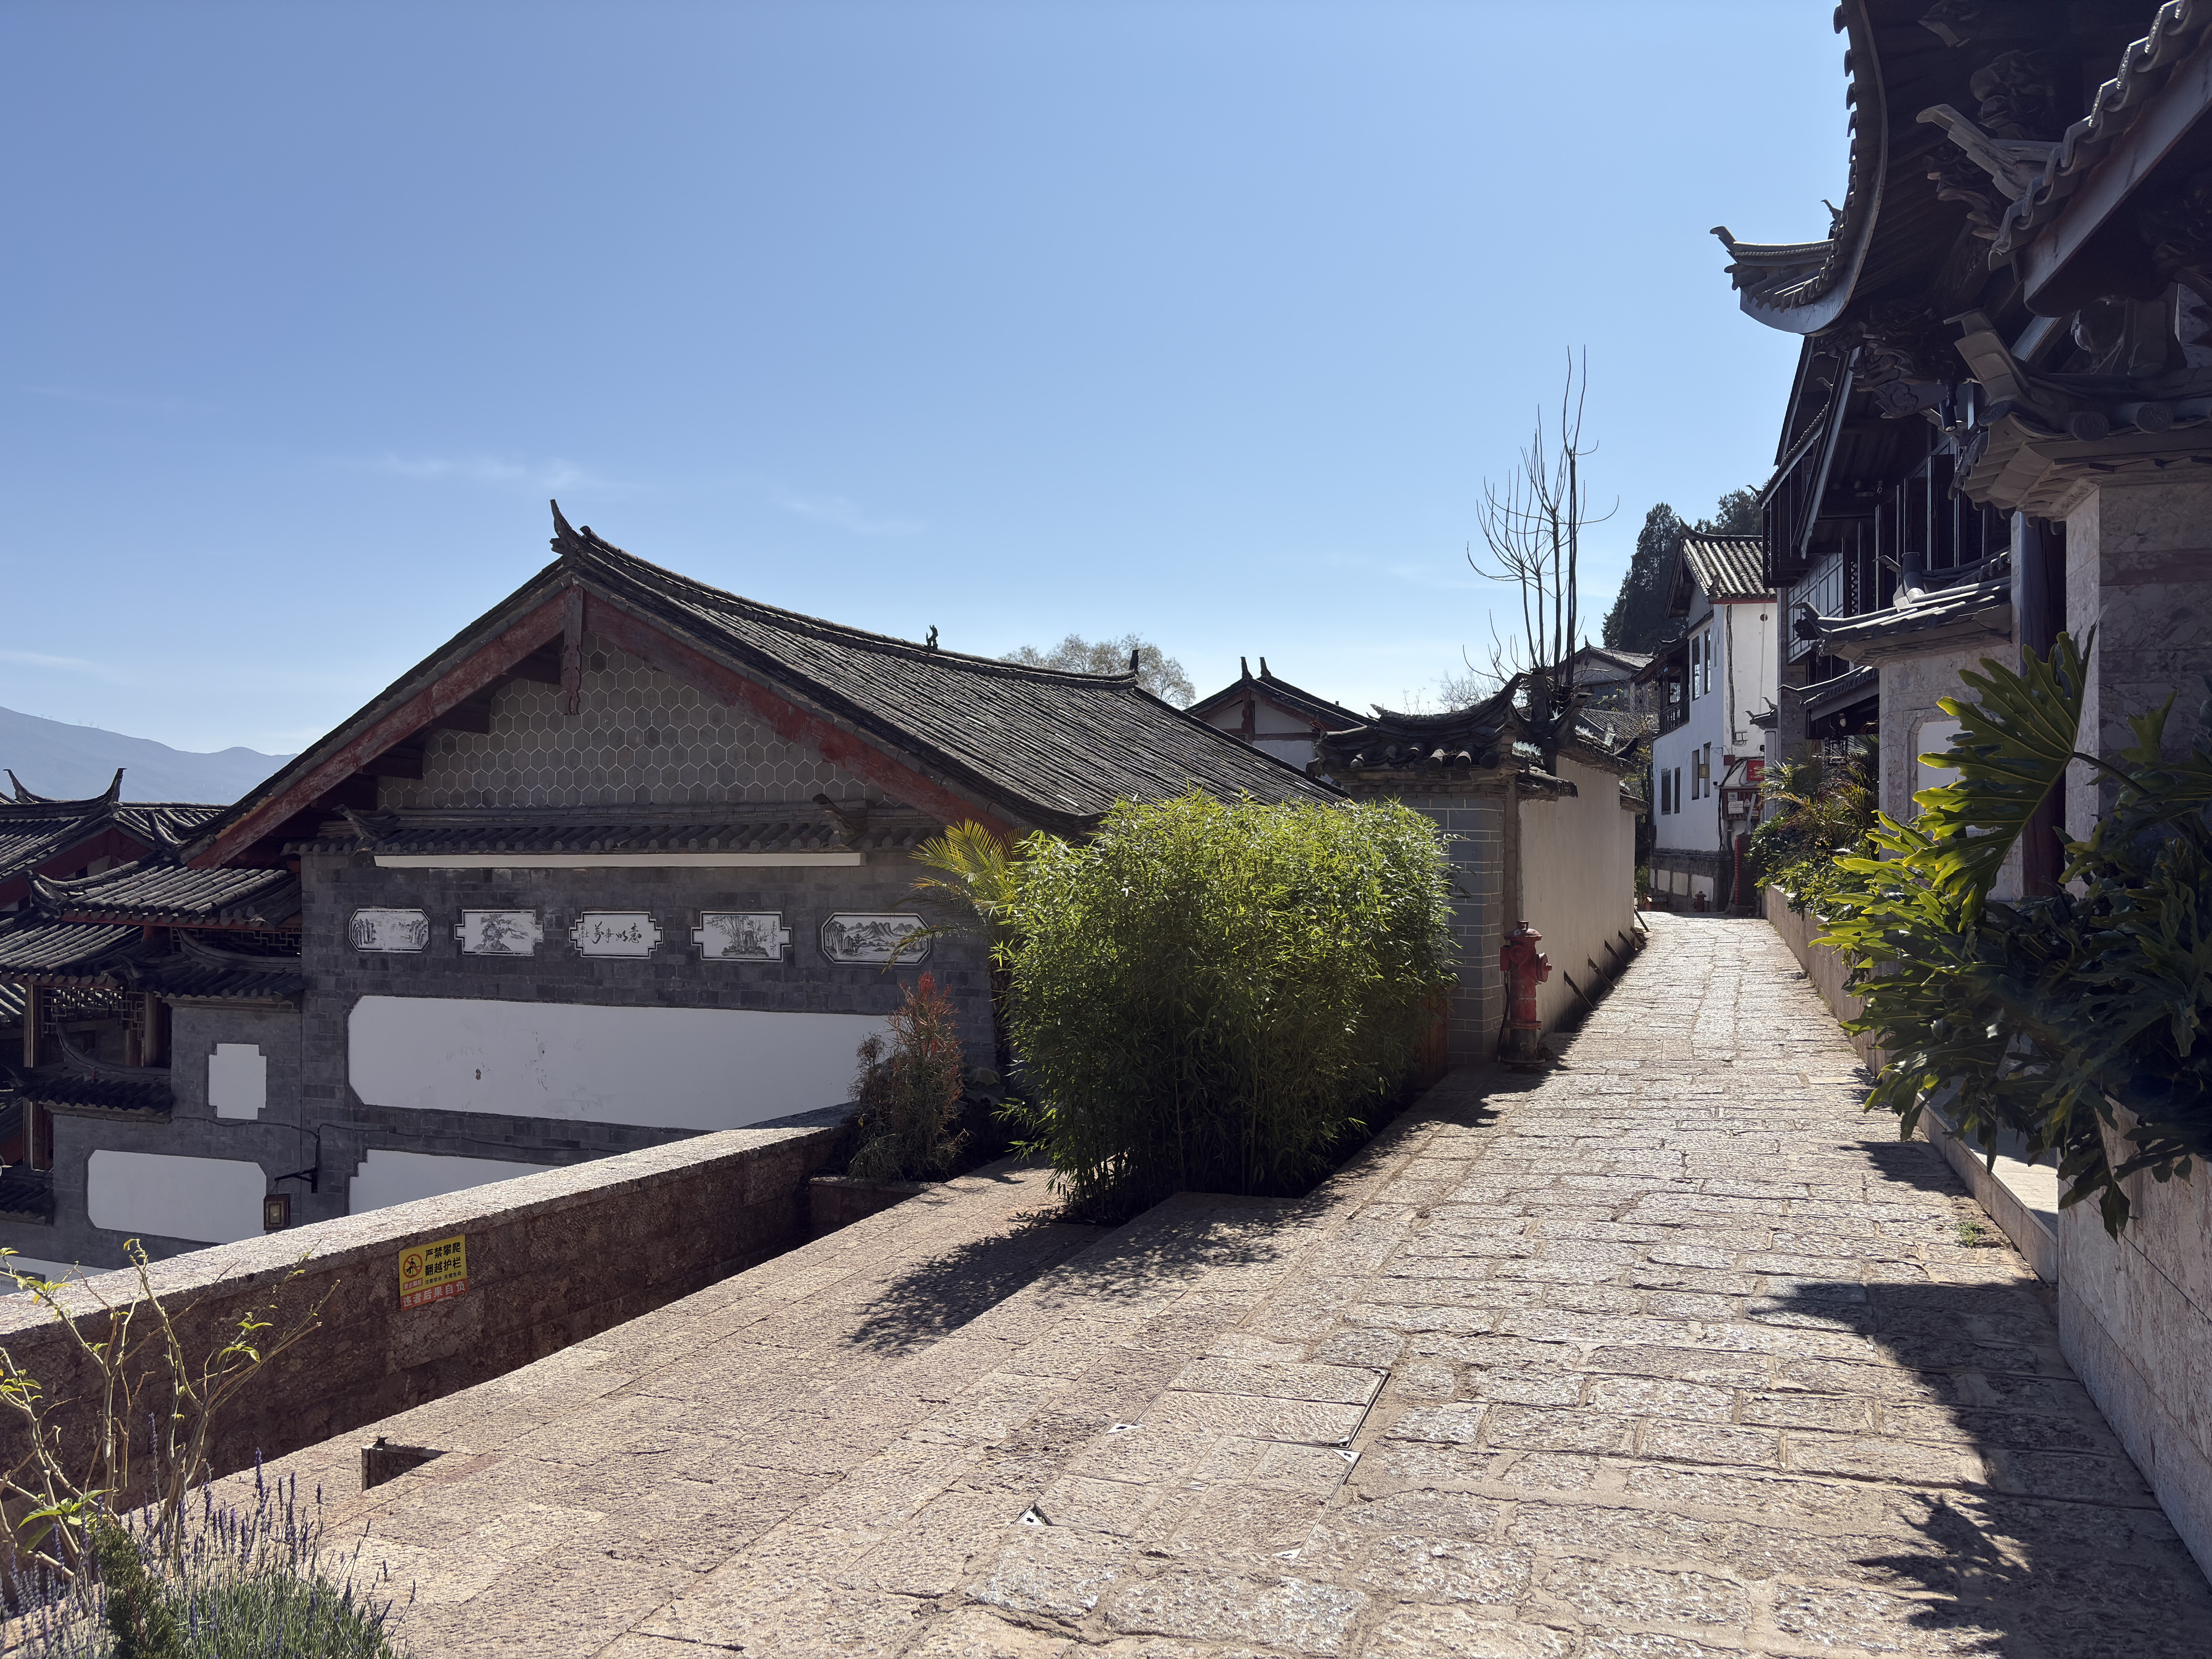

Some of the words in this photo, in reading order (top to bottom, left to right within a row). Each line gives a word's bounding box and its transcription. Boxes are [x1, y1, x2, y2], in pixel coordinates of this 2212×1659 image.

[425, 1242, 461, 1261] 严禁攀爬
[425, 1256, 461, 1276] 翻越护栏
[404, 1279, 422, 1290] 禁止翻越
[425, 1276, 441, 1285] 注意安全
[444, 1271, 461, 1279] 关爱生命
[403, 1281, 465, 1307] 违者后果自负
